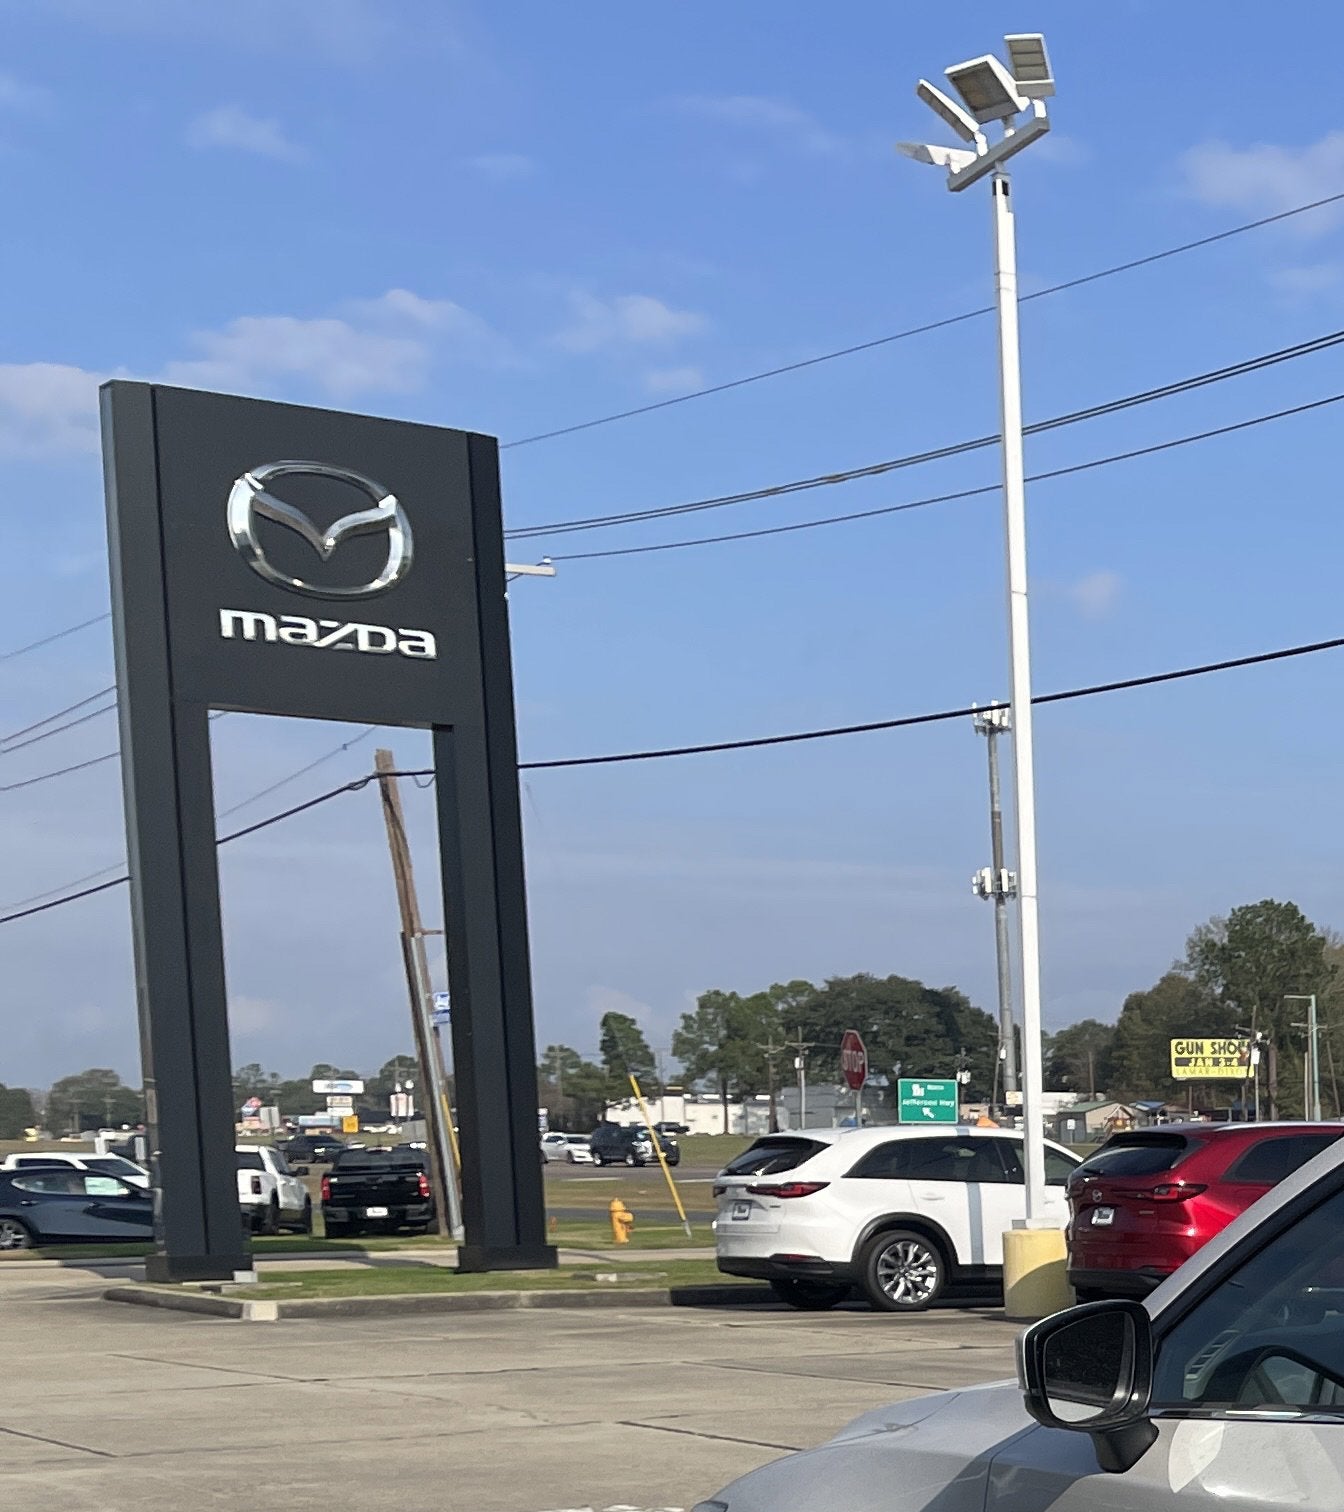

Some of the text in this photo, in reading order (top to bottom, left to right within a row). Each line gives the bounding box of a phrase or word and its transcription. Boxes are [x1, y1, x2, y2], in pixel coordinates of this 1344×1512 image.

[219, 608, 439, 660] mazda
[1174, 1041, 1204, 1056] GUN
[842, 1049, 865, 1073] STOP
